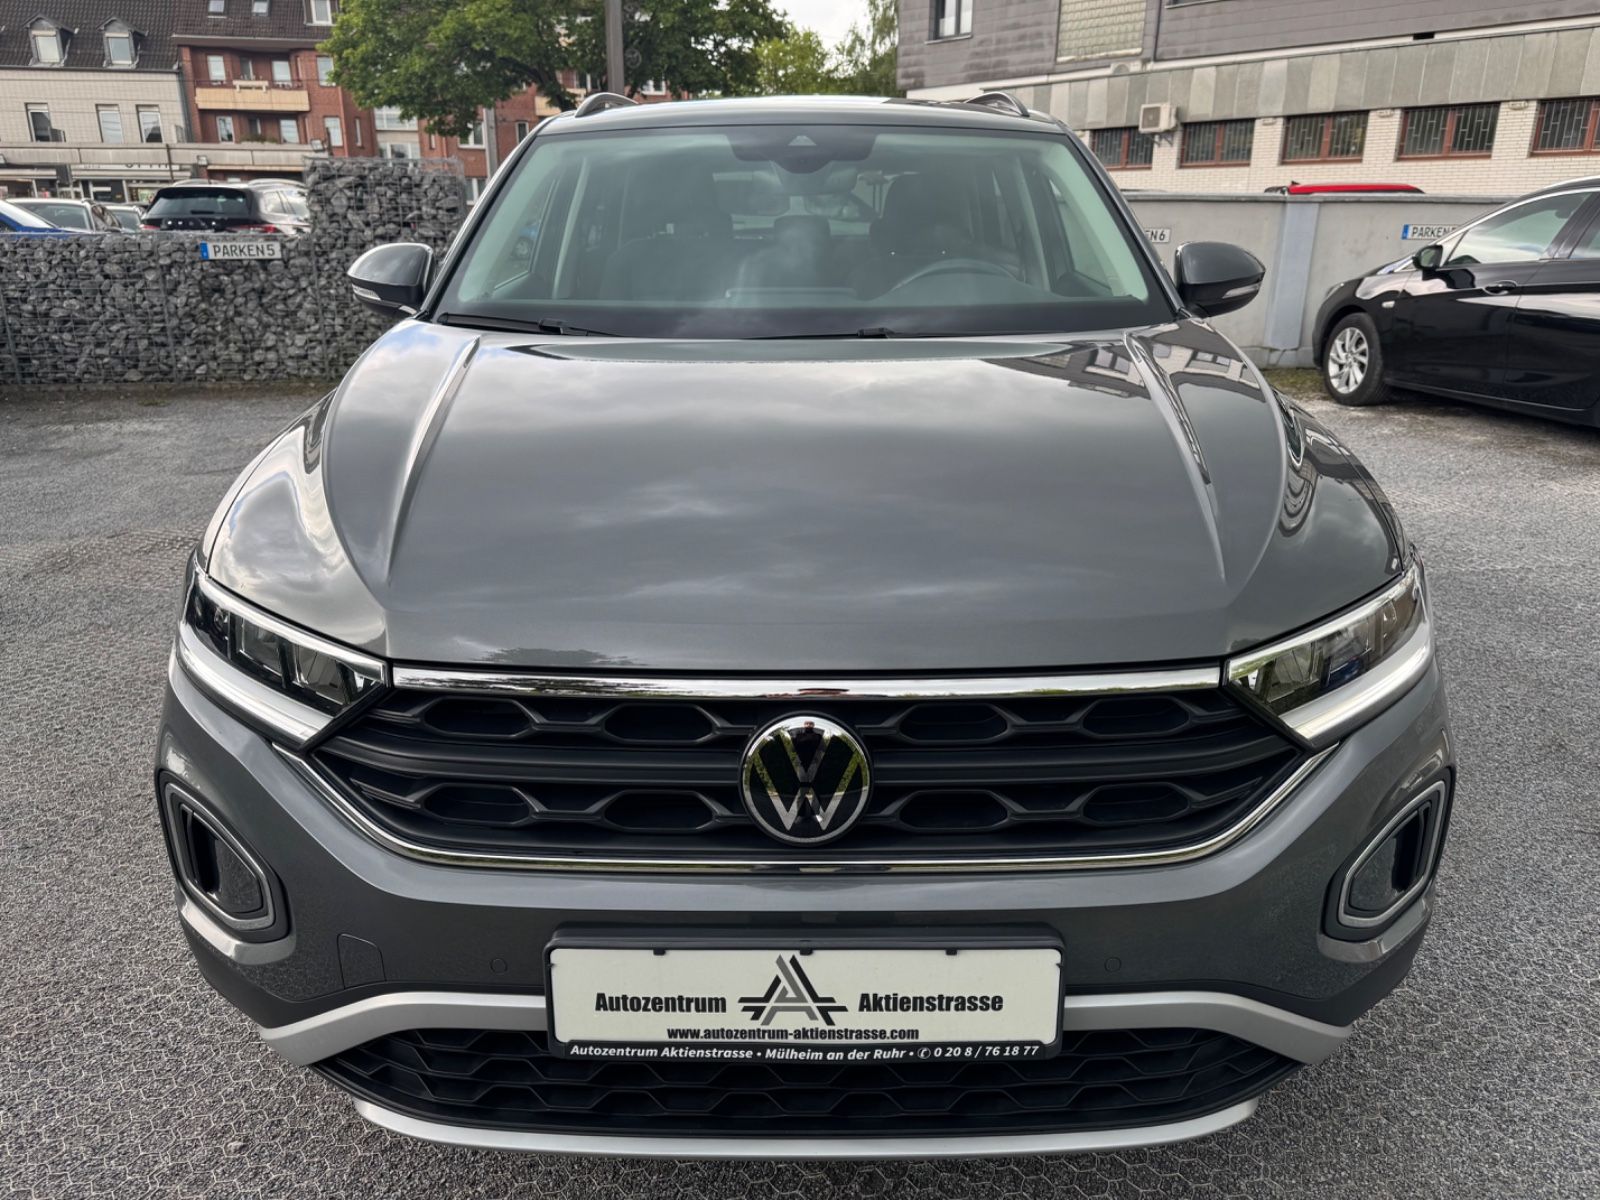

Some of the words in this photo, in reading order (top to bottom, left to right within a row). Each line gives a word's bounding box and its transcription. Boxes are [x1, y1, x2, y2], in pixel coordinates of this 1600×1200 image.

[595, 993, 727, 1013] Autozentrum
[858, 993, 1004, 1012] Aktienstrasse
[666, 1027, 919, 1040] www.autozentrum-aktienstrasse.com
[570, 1045, 659, 1057] Autozentrum
[660, 1047, 754, 1059] Aktienstrasse
[765, 1048, 824, 1061] Mülheim
[826, 1051, 845, 1061] an
[847, 1048, 871, 1060] der
[873, 1048, 907, 1060] Ruhr
